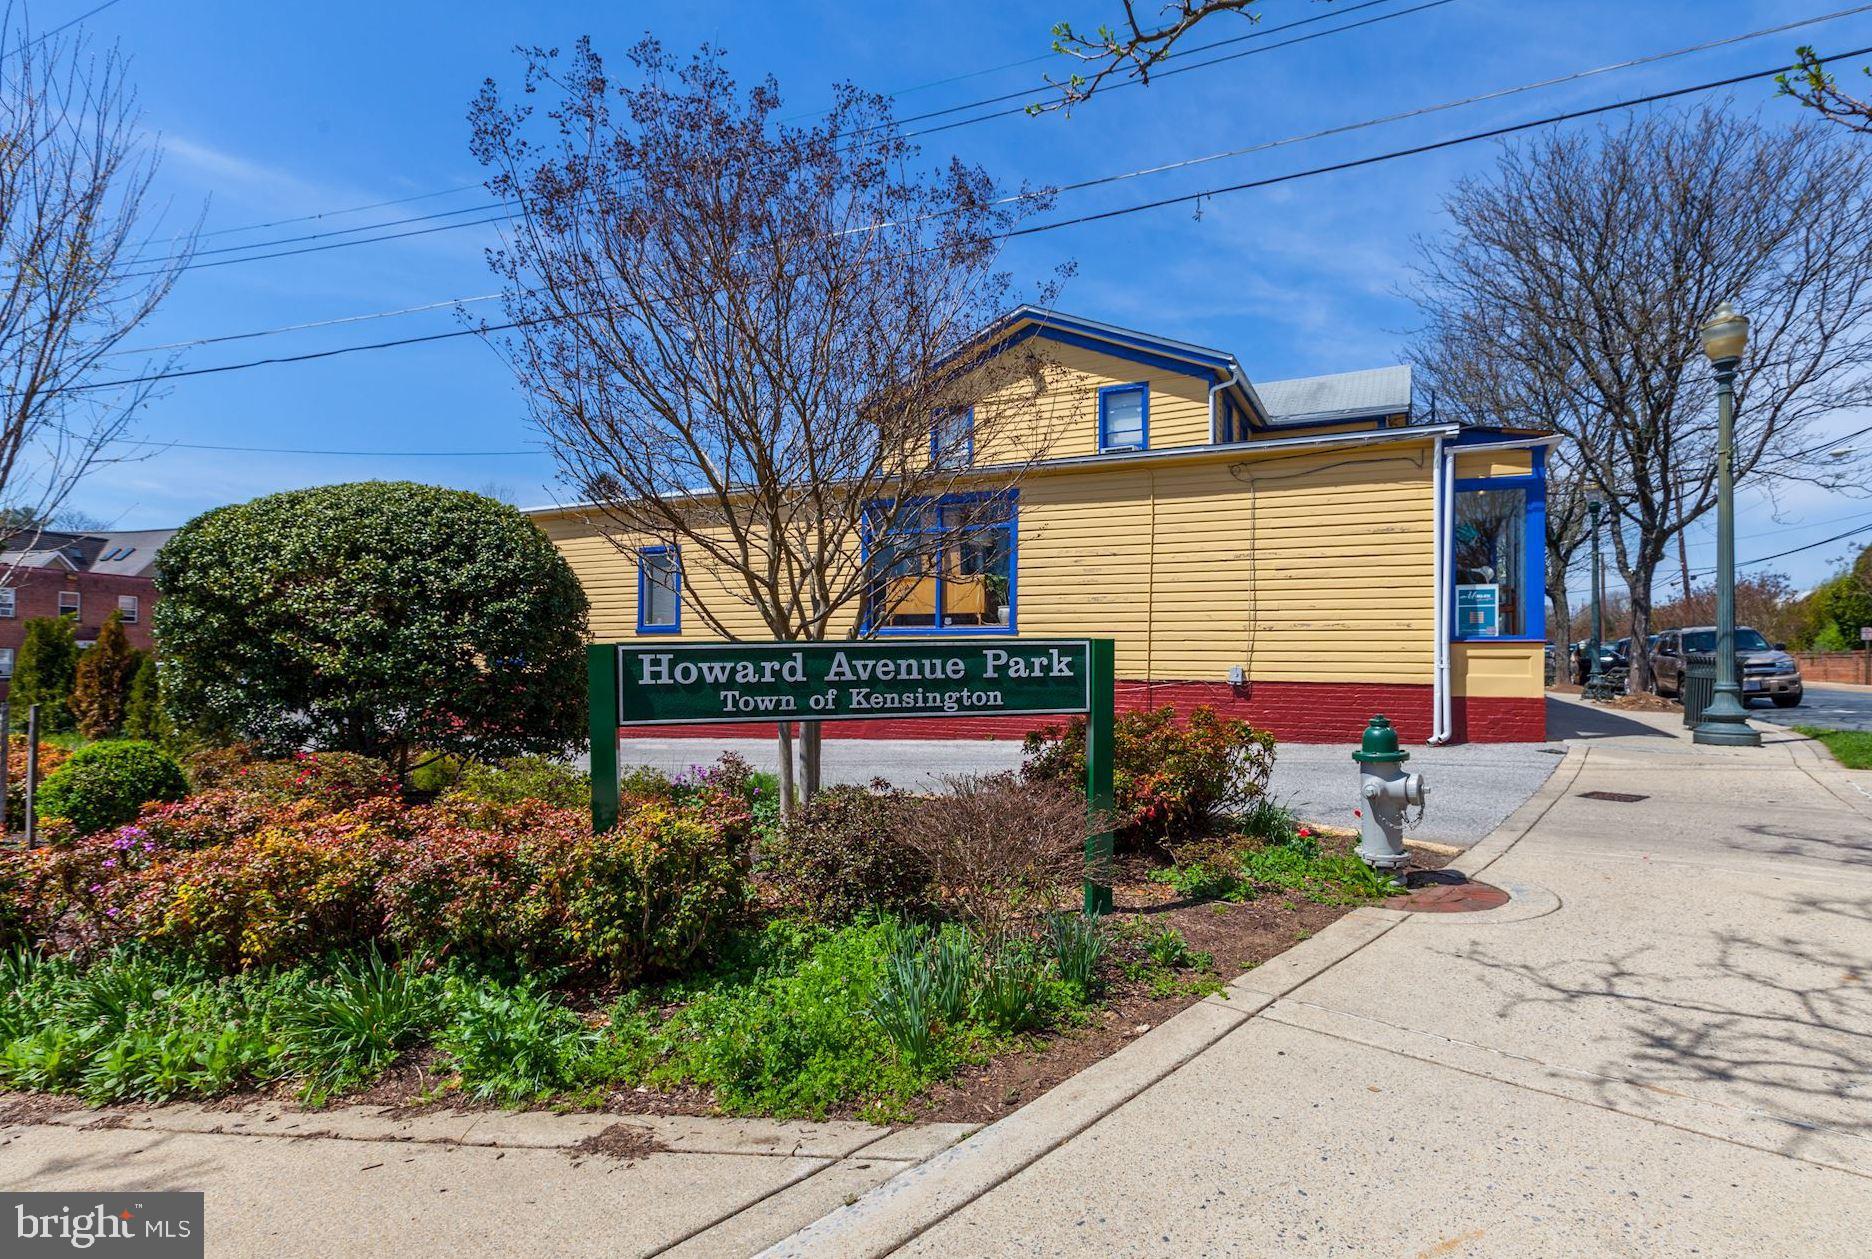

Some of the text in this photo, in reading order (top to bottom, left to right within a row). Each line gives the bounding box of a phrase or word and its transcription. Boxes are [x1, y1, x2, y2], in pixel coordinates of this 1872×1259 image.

[637, 648, 1074, 685] Howard Avenue Park
[720, 687, 1004, 712] Town of Kensington
